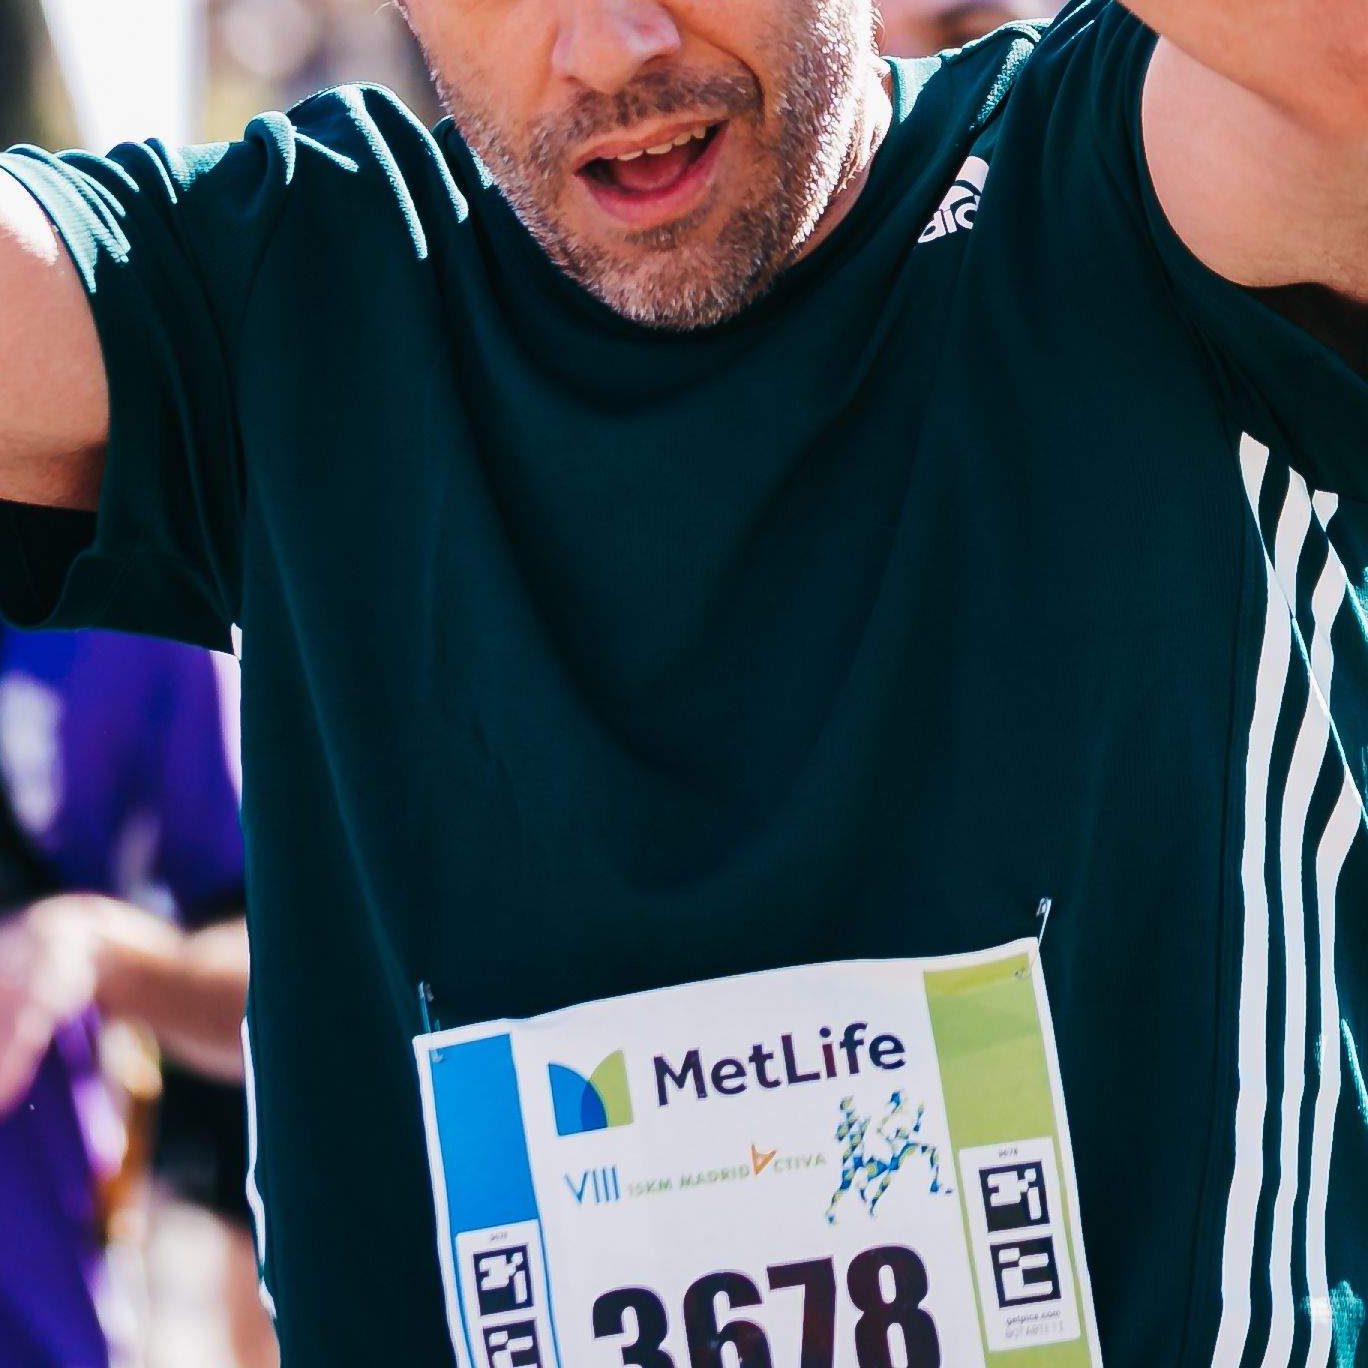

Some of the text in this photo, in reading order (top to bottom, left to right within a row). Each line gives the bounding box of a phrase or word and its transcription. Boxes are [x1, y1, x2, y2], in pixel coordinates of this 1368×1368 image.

[652, 1021, 907, 1106] MetLife
[563, 1165, 620, 1205] VIII
[680, 1163, 751, 1188] MADRID
[592, 1245, 941, 1368] 3678
